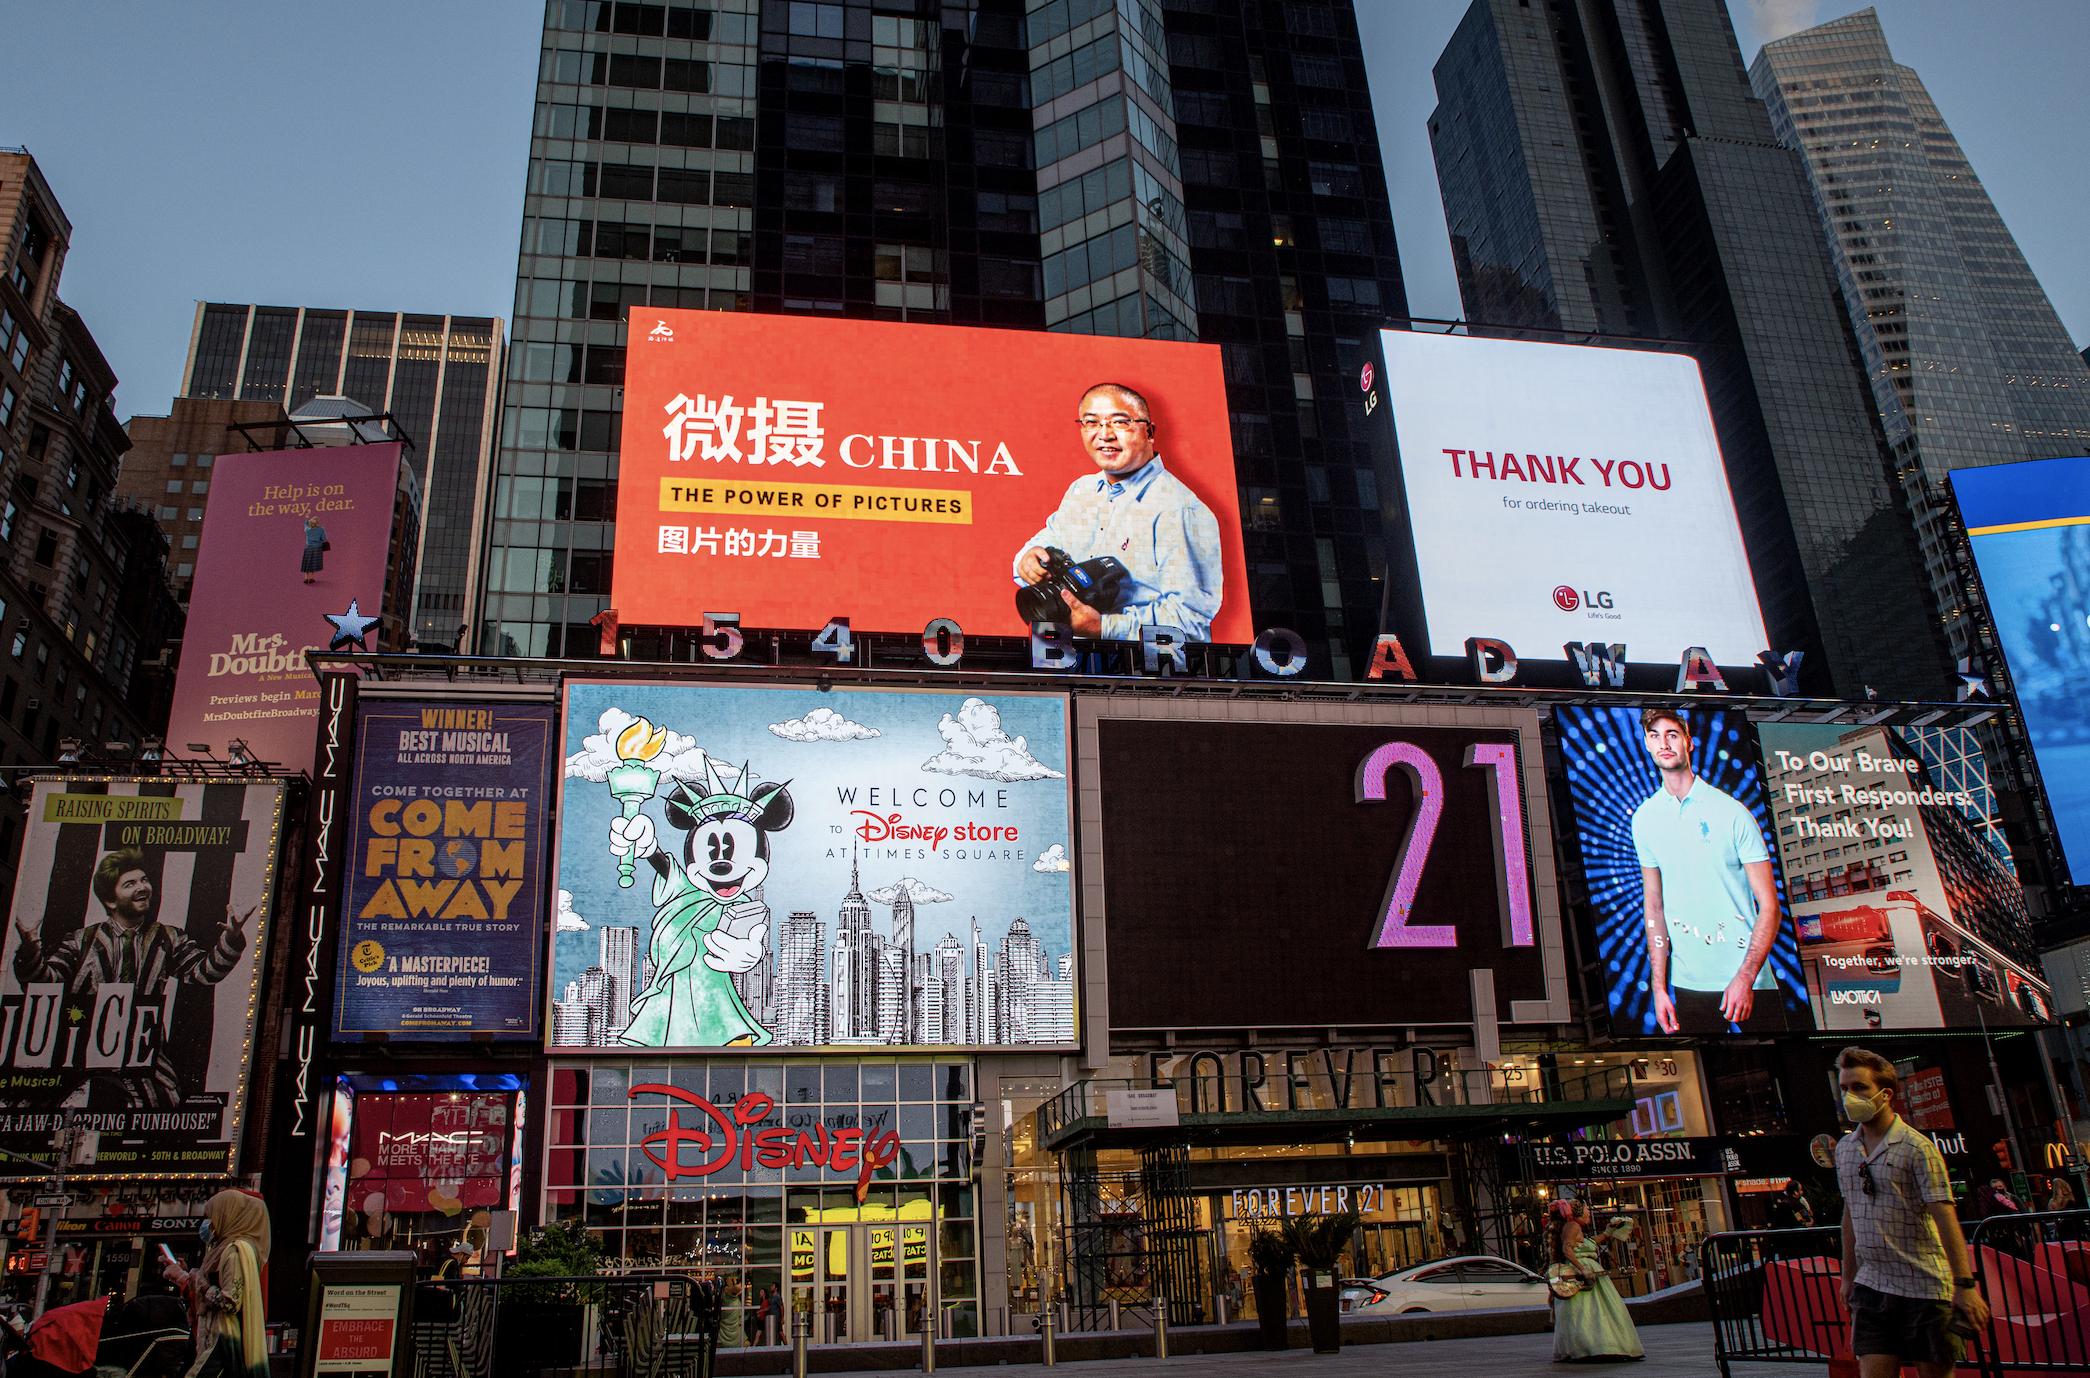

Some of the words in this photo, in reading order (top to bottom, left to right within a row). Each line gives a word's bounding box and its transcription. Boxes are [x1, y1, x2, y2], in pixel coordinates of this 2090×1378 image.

[1365, 390, 1378, 416] LG
[662, 393, 826, 468] 微摄
[839, 433, 1024, 476] CHINA
[1442, 448, 1585, 486] THANK
[1590, 458, 1672, 491] YOU
[263, 486, 303, 501] Help
[306, 483, 320, 498] is
[323, 484, 344, 497] on
[670, 486, 715, 503] THE
[725, 489, 804, 508] POWER
[815, 493, 843, 509] OF
[854, 495, 962, 514] PICTURES
[248, 502, 275, 517] the
[278, 502, 311, 518] way,
[315, 497, 355, 513] dear.
[1502, 496, 1521, 508] for
[1525, 499, 1579, 516] ordering
[1582, 501, 1631, 516] takeout
[658, 525, 821, 559] 图片的力量
[1583, 591, 1614, 609] LG
[228, 632, 288, 656] Mrs.
[590, 608, 965, 666] 1540
[1028, 621, 1804, 695] BROADWAY
[266, 674, 282, 682] New
[210, 692, 258, 706] Previews
[260, 691, 291, 703] begin
[421, 709, 493, 730] WINNER!
[399, 730, 439, 751] BEST
[442, 731, 512, 753] MUSICAL
[397, 753, 413, 763] ALL
[414, 753, 447, 764] ACROSS
[449, 754, 475, 765] NORTH
[476, 755, 512, 766] AMERICA
[1774, 750, 1804, 771] To
[1809, 751, 1852, 772] Our
[1857, 752, 1920, 773] Brave
[371, 785, 417, 797] COME
[422, 786, 505, 798] TOGETHER
[509, 788, 529, 798] AT
[837, 786, 1008, 808] WELCOME
[1784, 783, 1838, 804] First
[1840, 784, 1973, 810] Responders:
[55, 800, 113, 818] RAISING
[117, 801, 170, 820] SPIRITS
[369, 798, 527, 839] COME
[121, 826, 142, 845] ON
[145, 826, 231, 846] BROADWAY!
[829, 825, 842, 834] TO
[850, 810, 948, 852] Disney
[953, 821, 1019, 841] store
[1790, 816, 1862, 838] Thank
[1863, 817, 1915, 838] You!
[826, 848, 847, 859] AT
[863, 848, 925, 860] TIMES
[942, 849, 1025, 860] SQUARE
[1354, 741, 1535, 949] 21
[365, 837, 526, 879] FROM
[358, 877, 525, 920] AWAY
[357, 923, 378, 931] THE
[380, 922, 452, 931] REMARKABLE
[455, 923, 482, 931] TRUE
[485, 923, 520, 932] STORY
[359, 955, 380, 965] Critic's
[363, 960, 378, 968] Pick
[401, 956, 490, 973] MASTERPIECE!
[1822, 954, 1881, 970] Together,
[1884, 954, 1919, 966] we're
[1921, 955, 1978, 970] stronger.
[356, 975, 390, 988] Joyous,
[391, 975, 429, 988] uplifting
[430, 976, 447, 986] and
[448, 976, 476, 989] plenty
[477, 975, 489, 986] of
[1654, 1060, 1677, 1077] $30
[11, 1075, 63, 1088] Musical.
[379, 1144, 418, 1154] MORE
[420, 1144, 457, 1154] THAN
[1931, 1131, 1969, 1154] hut
[32, 1150, 50, 1162] WAY
[97, 1150, 137, 1162] HERWORLD
[151, 1150, 172, 1162] 50TH
[173, 1151, 180, 1161] &
[181, 1150, 226, 1161] BROADWAY
[377, 1154, 423, 1166] MEETS
[427, 1154, 453, 1165] THE
[454, 1154, 479, 1165] EYE
[1534, 1147, 1573, 1165] U.S.
[1575, 1144, 1632, 1164] POLO
[1637, 1142, 1697, 1162] ASSN.
[1591, 1165, 1618, 1175] SINCE
[1621, 1164, 1642, 1174] 1890
[1232, 1185, 1349, 1218] FOREVER
[1362, 1184, 1384, 1212] 21
[94, 1220, 141, 1231] Canon
[151, 1218, 200, 1229] SONY
[106, 1253, 130, 1263] 1550
[332, 1321, 385, 1332] EMBRACE
[349, 1335, 364, 1343] THE
[332, 1346, 378, 1358] ABSURD
